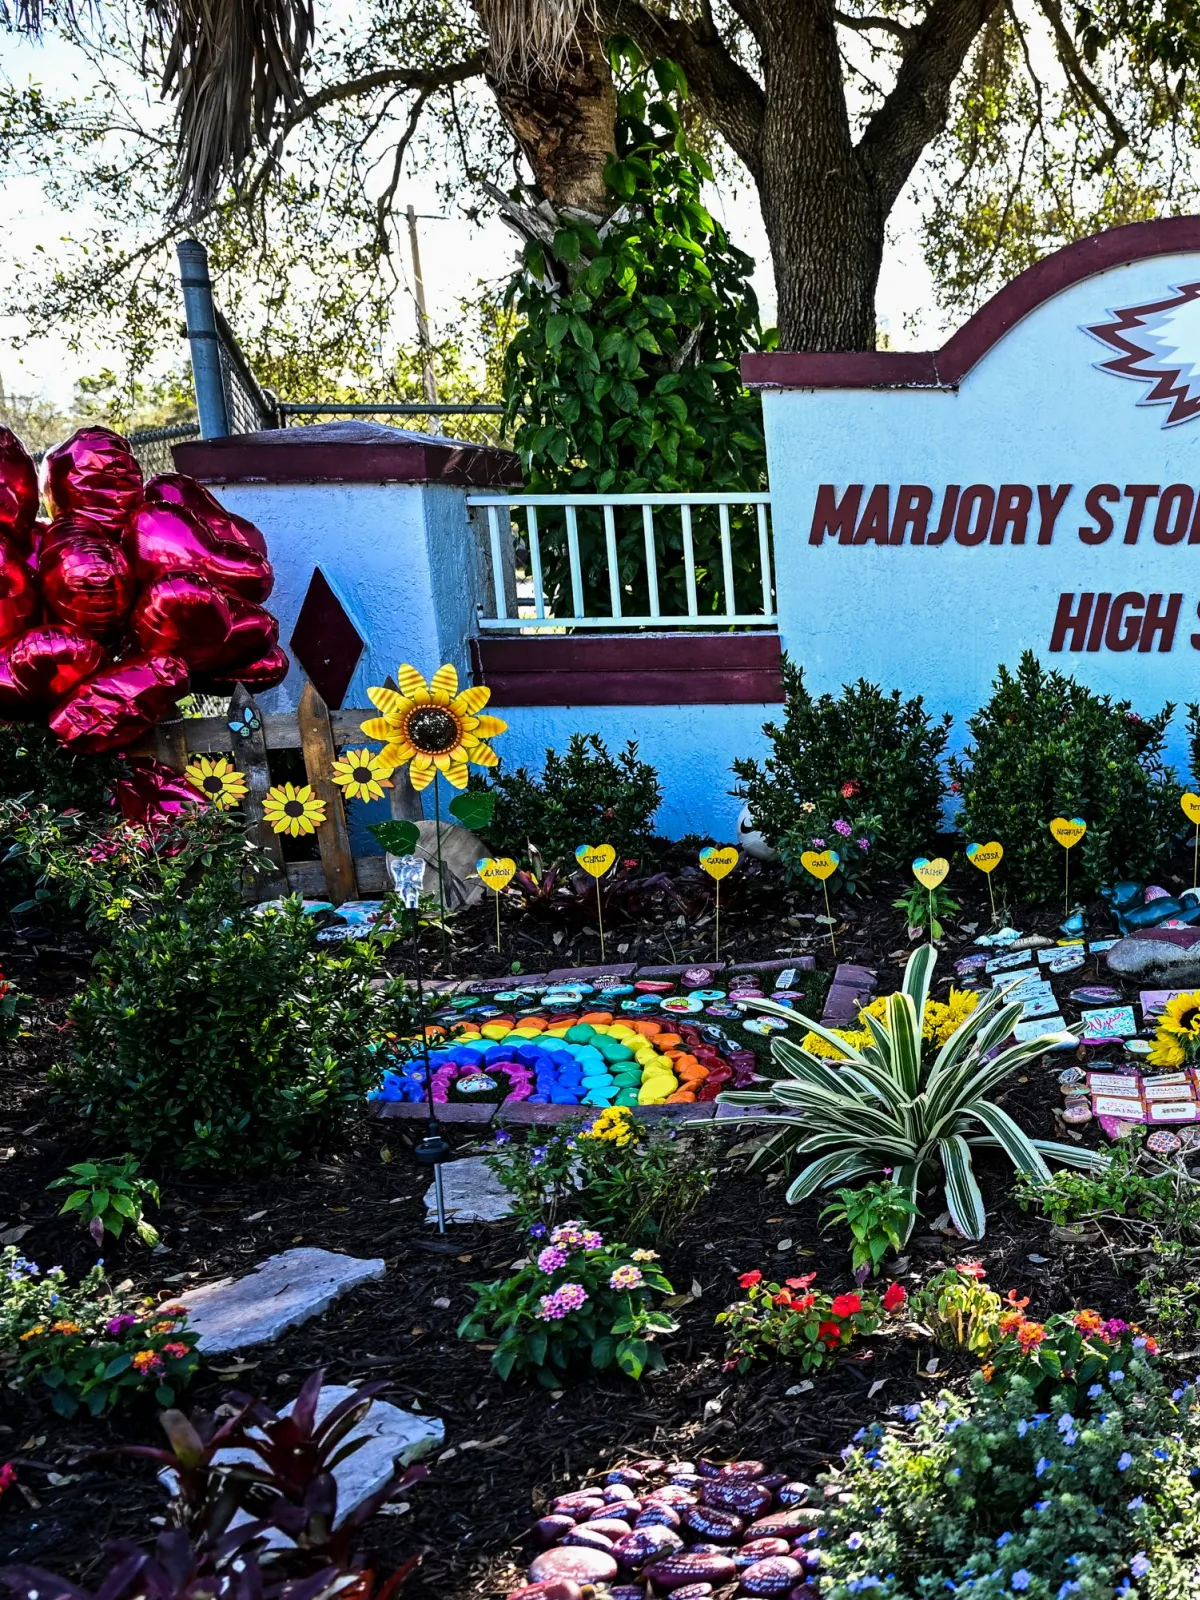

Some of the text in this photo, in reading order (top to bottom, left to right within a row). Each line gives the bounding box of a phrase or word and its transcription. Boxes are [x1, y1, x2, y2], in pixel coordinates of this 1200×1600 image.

[808, 483, 1073, 546] MARJORY
[1048, 592, 1183, 653] HIGH
[582, 854, 607, 864] CHRIS
[973, 851, 1000, 863] ALYSSA
[483, 868, 511, 877] AARON
[1088, 1011, 1126, 1031] Alyssa
[1099, 1106, 1143, 1115] ALAINA
[707, 1485, 750, 1498] STRONG
[745, 1525, 778, 1536] MSD
